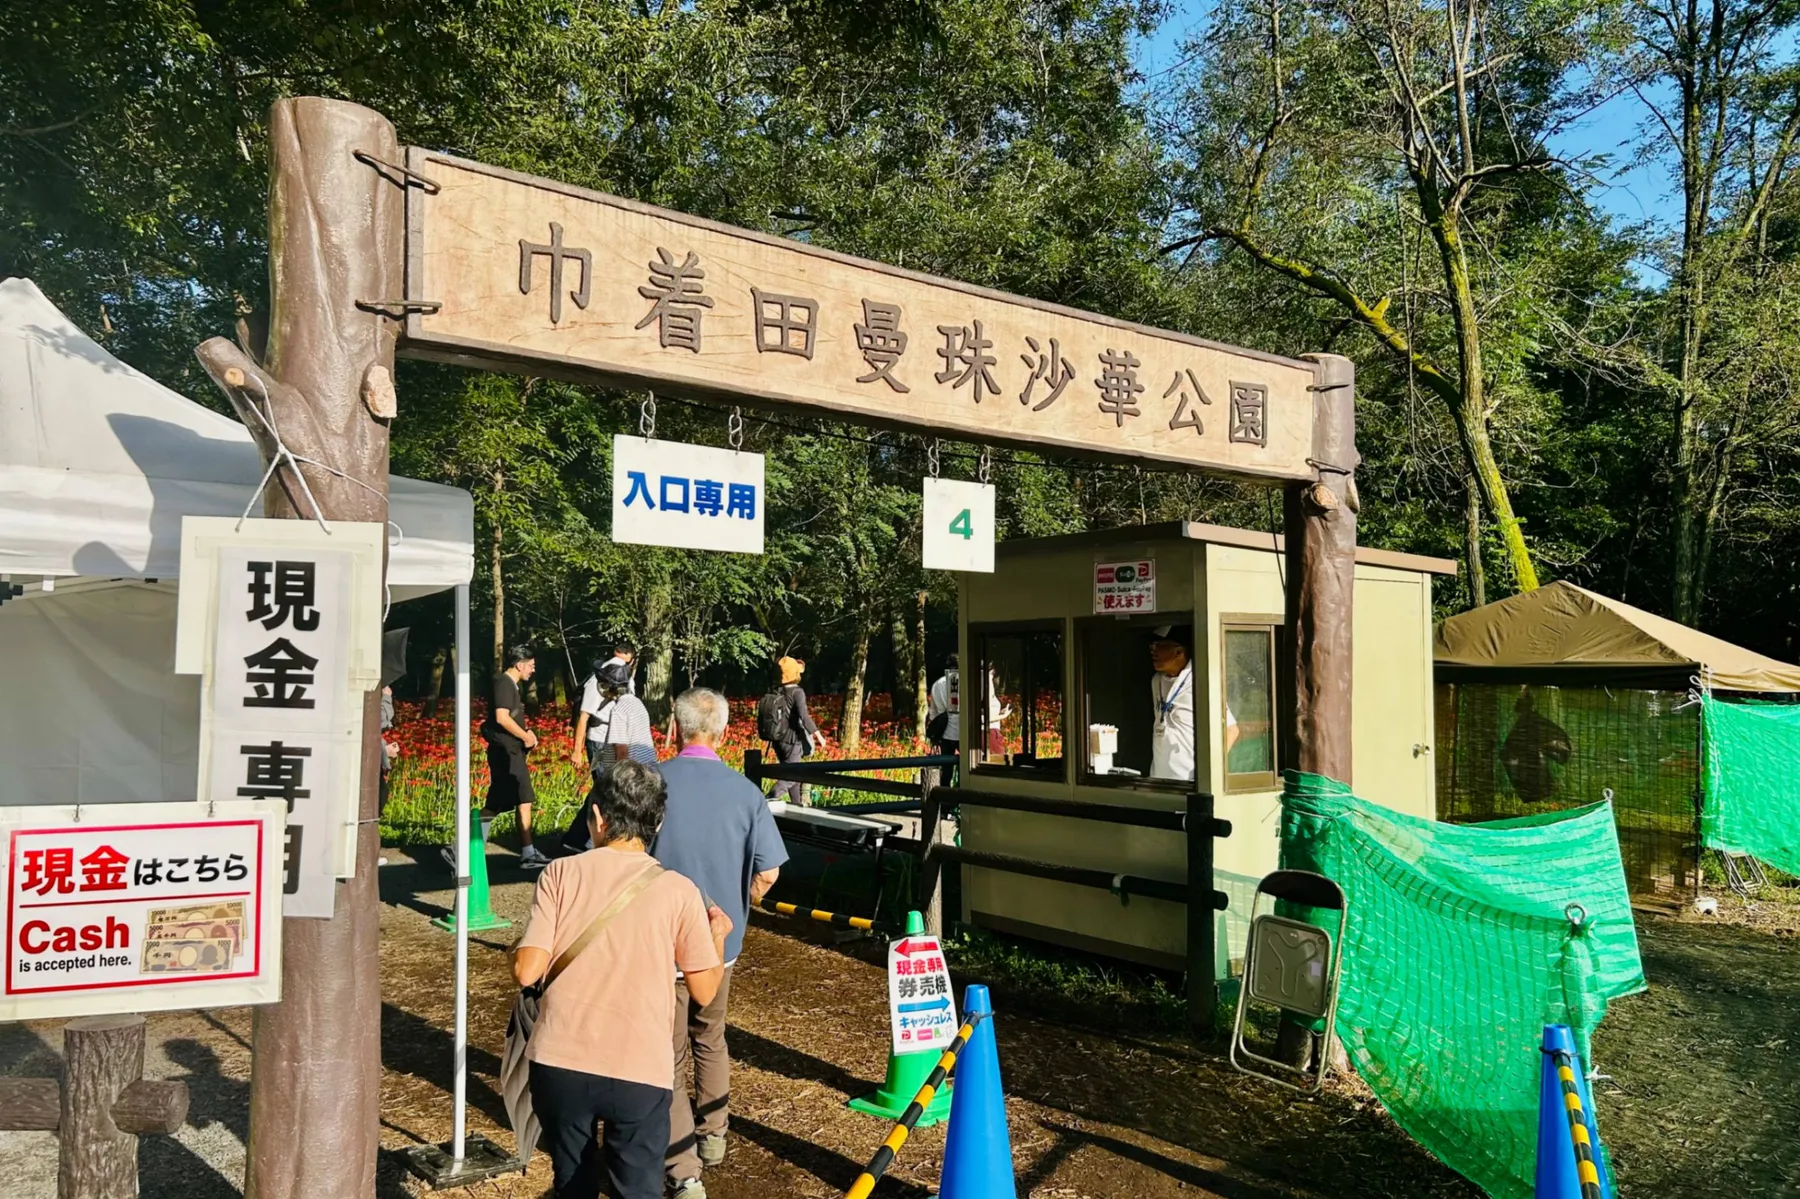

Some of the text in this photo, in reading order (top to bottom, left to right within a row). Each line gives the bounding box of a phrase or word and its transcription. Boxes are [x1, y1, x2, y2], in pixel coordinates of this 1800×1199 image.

[519, 221, 1268, 449] 巾着田曼珠沙華公園
[623, 470, 756, 520] 入口専用
[949, 508, 973, 540] 4
[1103, 594, 1144, 609] 使えます
[21, 845, 248, 896] 現金はこちら
[19, 916, 129, 954] Cash
[19, 954, 132, 973] is accepted here.
[896, 957, 944, 976] 現金専用
[898, 974, 947, 998] 券売機
[899, 1011, 953, 1029] キャッシュレス
